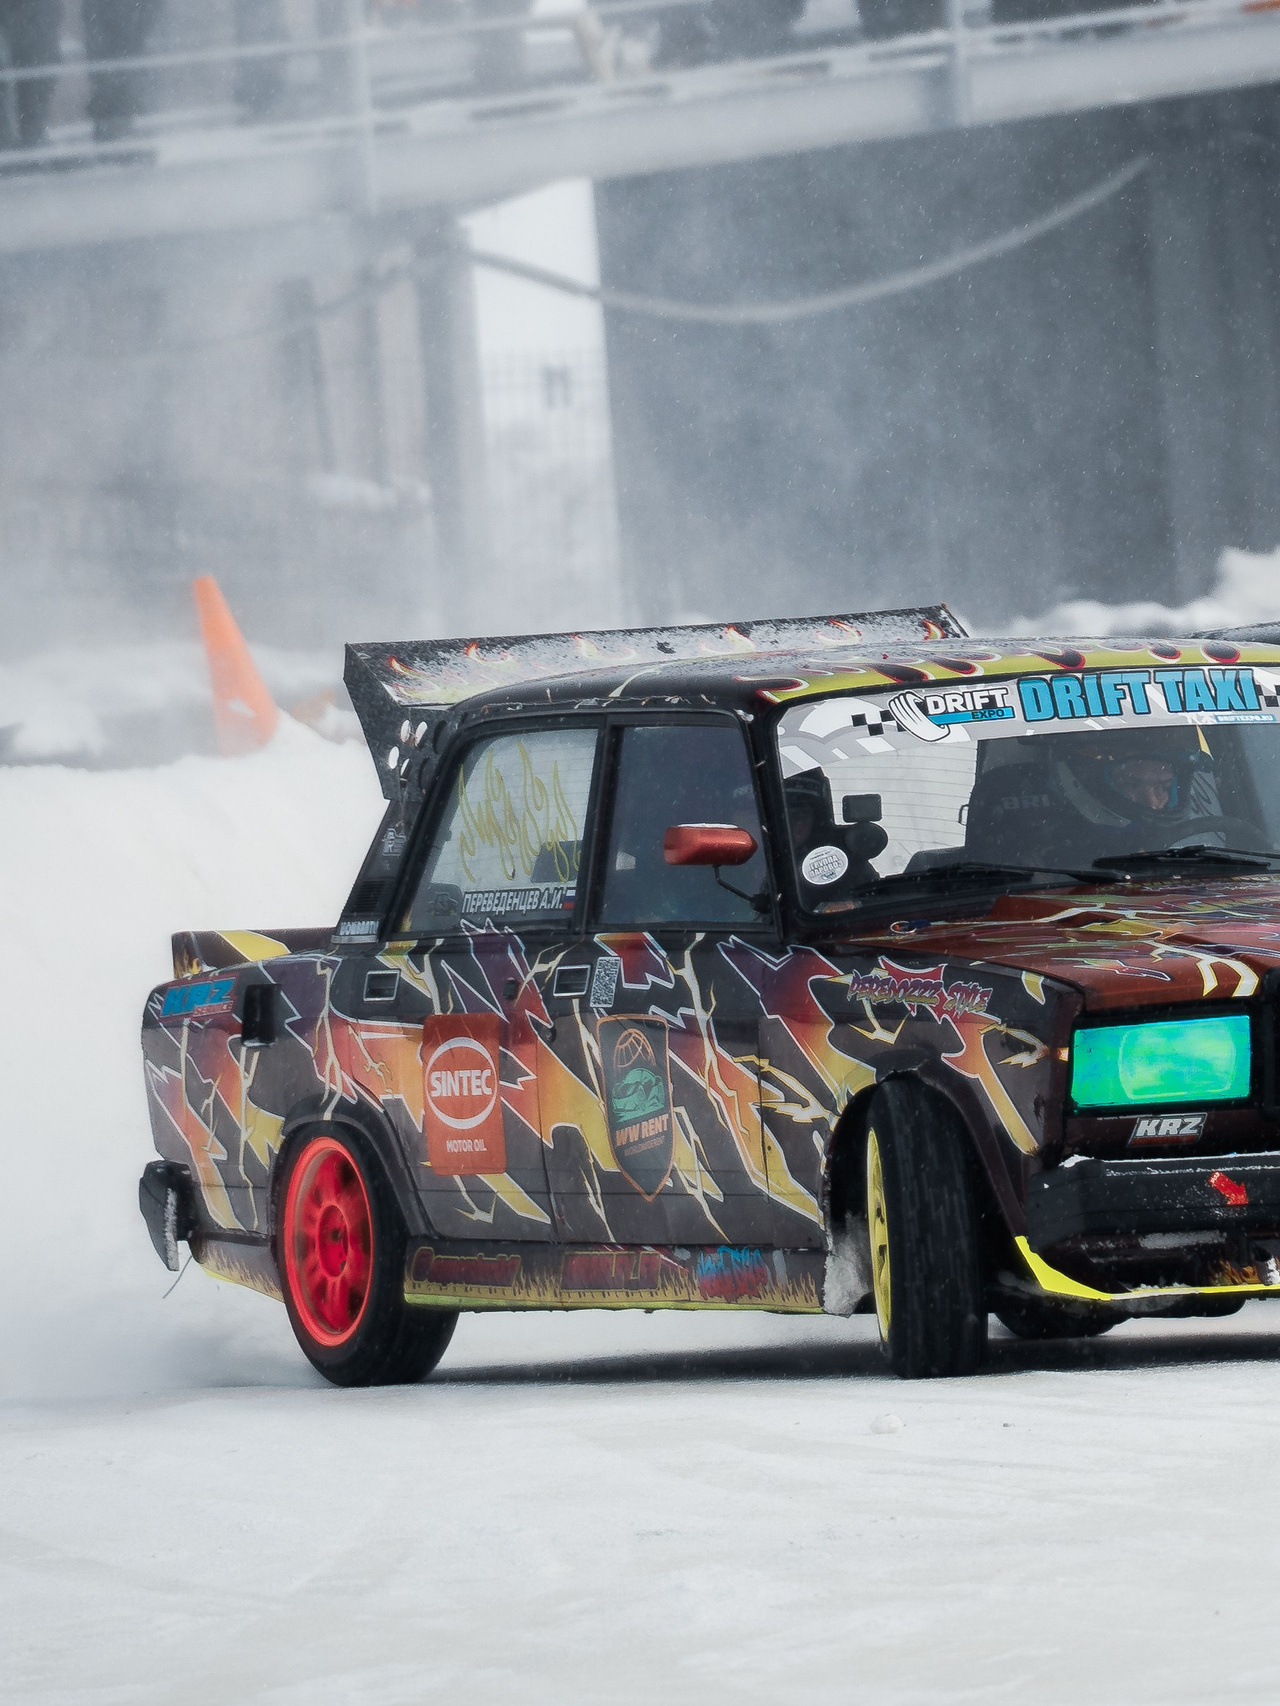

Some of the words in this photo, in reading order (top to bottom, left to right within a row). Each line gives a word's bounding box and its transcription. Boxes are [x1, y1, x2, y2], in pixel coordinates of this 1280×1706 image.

[927, 688, 1009, 715] DRIFT
[1017, 670, 1151, 722] DRIFT
[1153, 668, 1262, 713] TAXI
[971, 709, 1005, 720] EXPO
[461, 890, 541, 915] ПЕРЕВЕДЕНЦЕВ
[540, 888, 563, 909] А.И.
[430, 1069, 493, 1097] SINTEC
[615, 1123, 640, 1147] WW
[641, 1113, 669, 1139] RENT
[1135, 1116, 1203, 1137] KRZ
[446, 1139, 474, 1153] MOTOR
[473, 1138, 488, 1152] OIL
